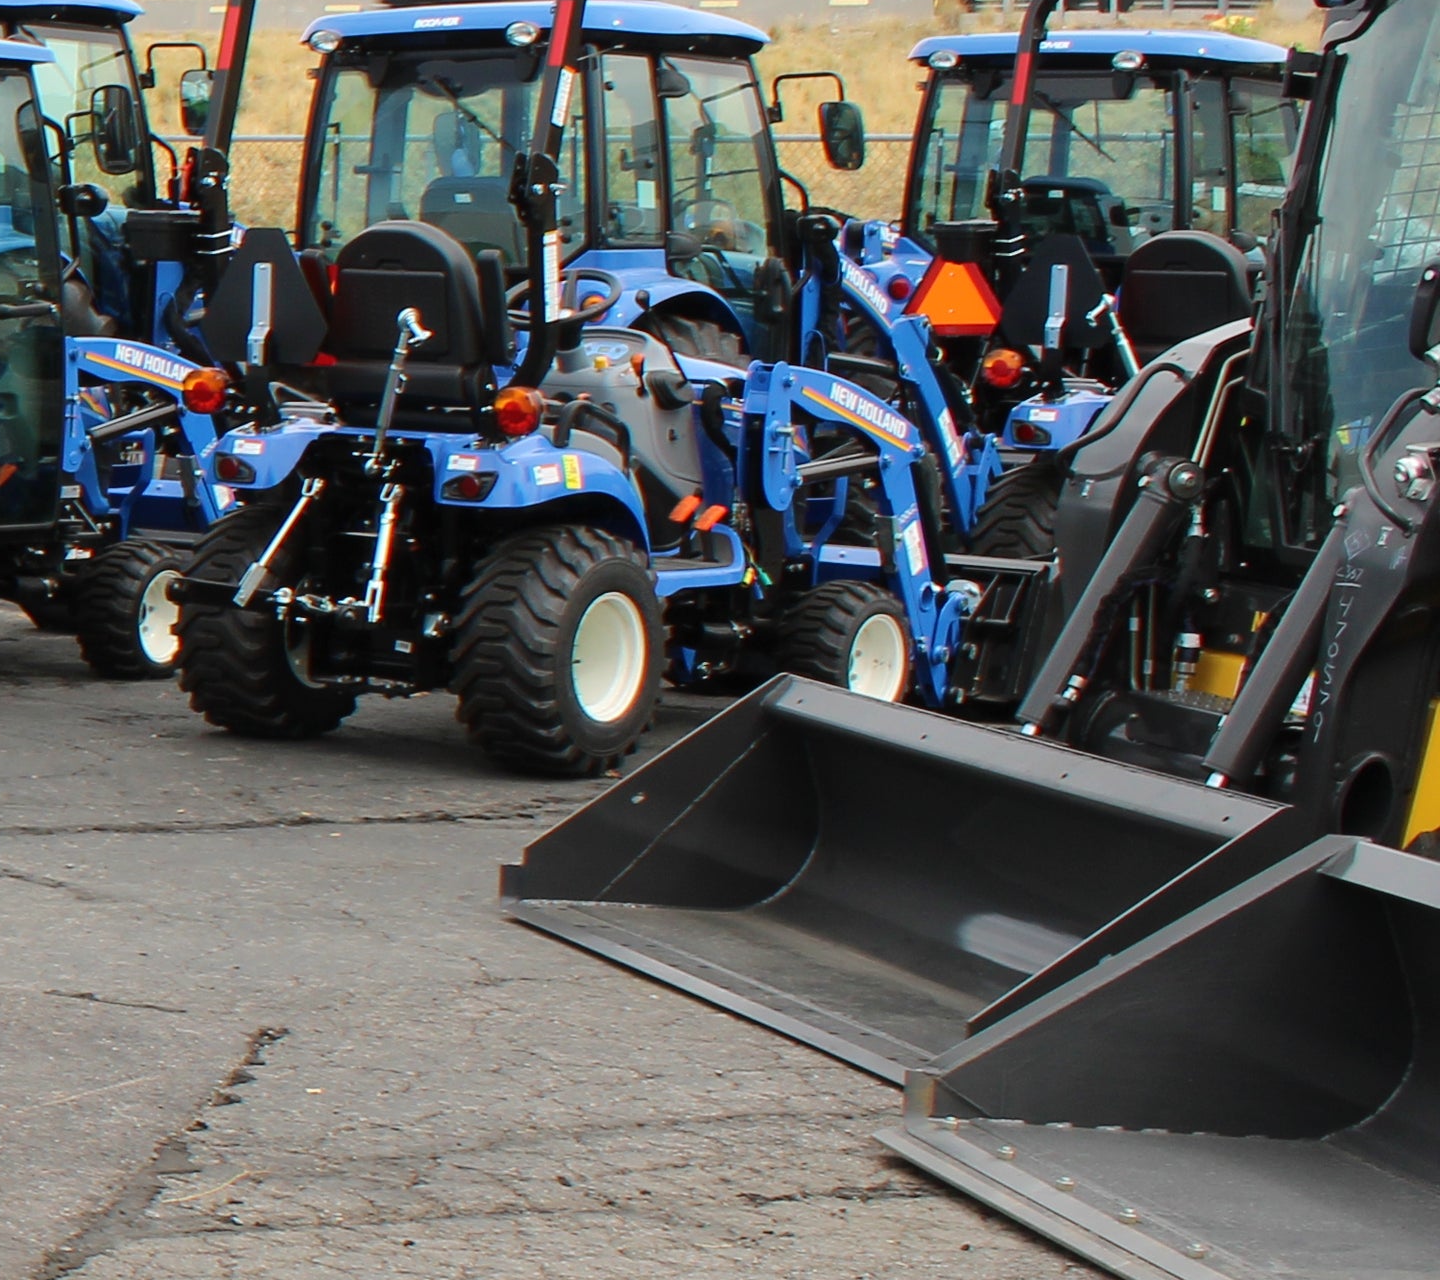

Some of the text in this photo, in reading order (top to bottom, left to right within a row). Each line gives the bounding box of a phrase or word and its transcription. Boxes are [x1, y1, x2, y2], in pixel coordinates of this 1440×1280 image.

[114, 343, 144, 367] NEW
[829, 382, 859, 410] NEW
[855, 397, 907, 440] HOLLAND
